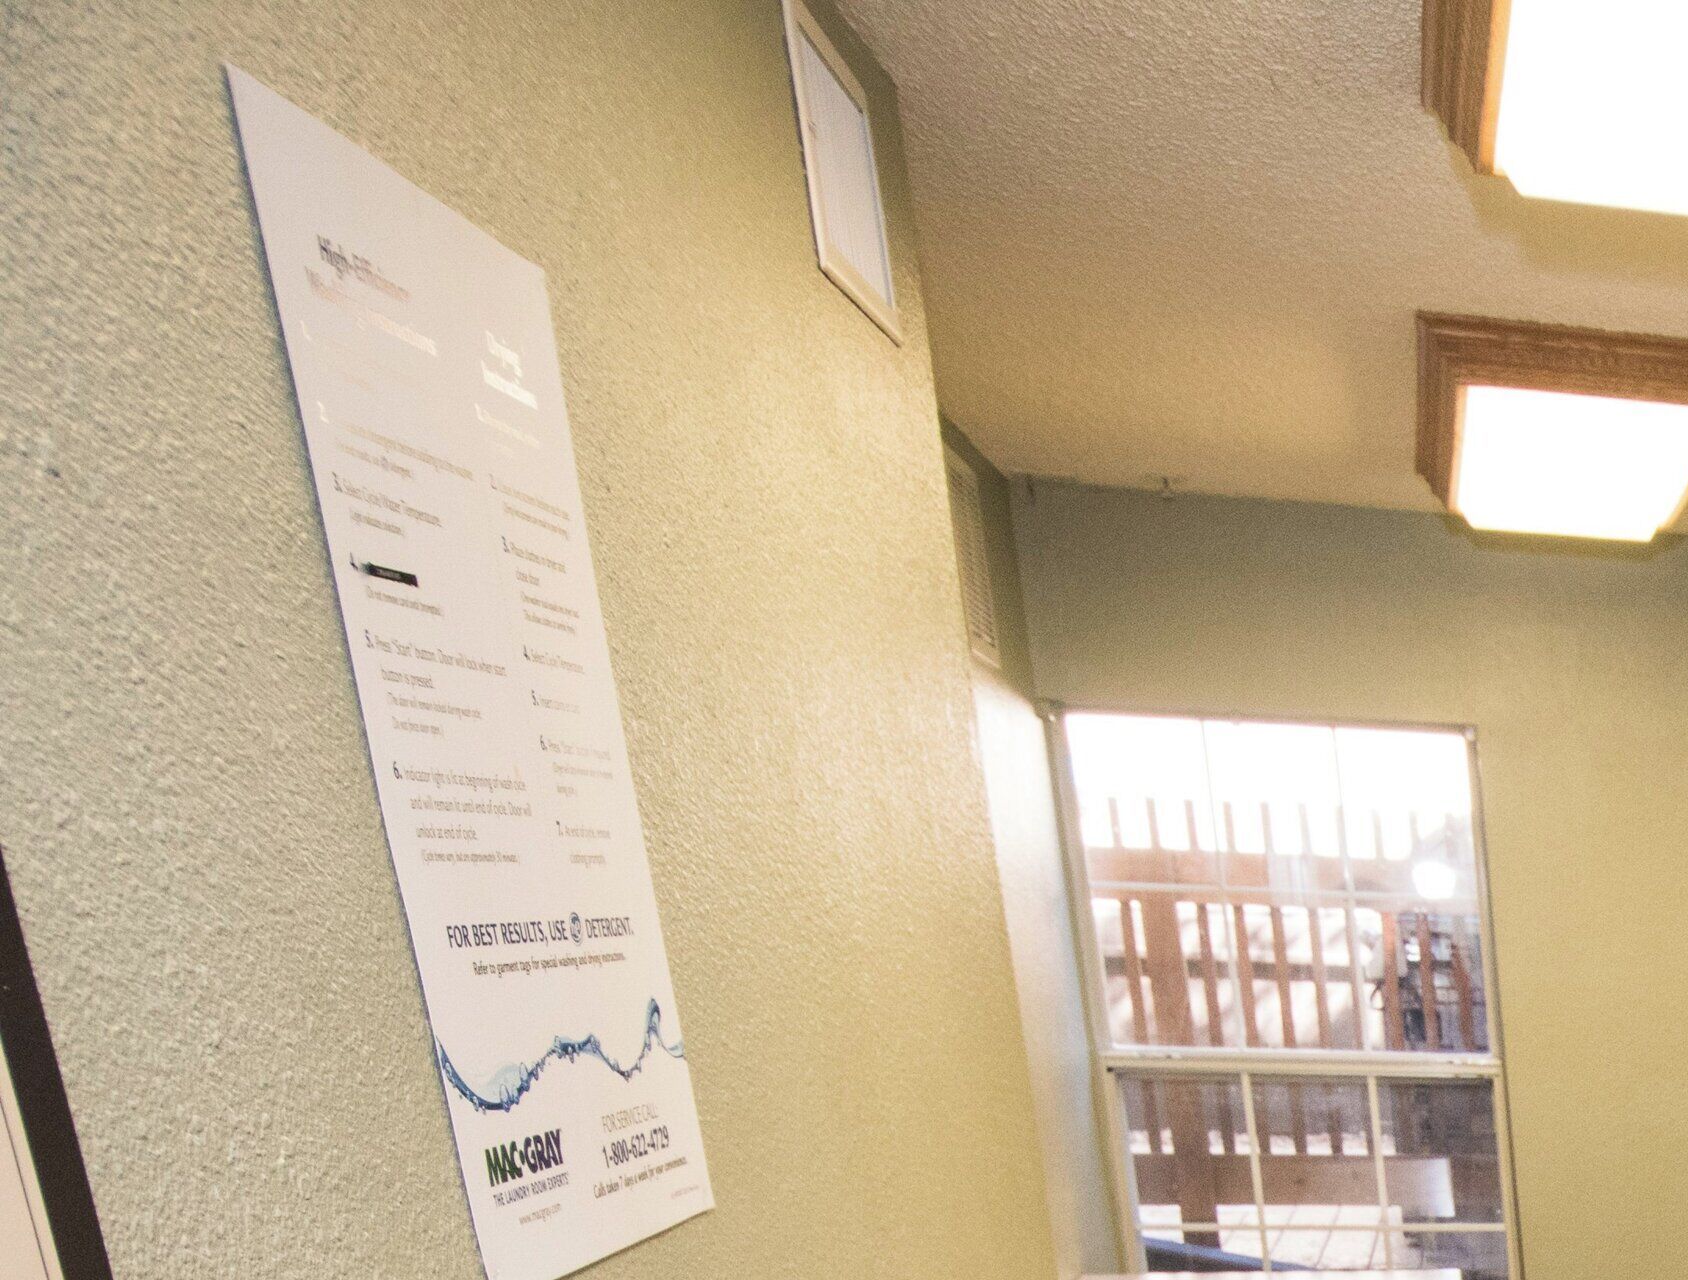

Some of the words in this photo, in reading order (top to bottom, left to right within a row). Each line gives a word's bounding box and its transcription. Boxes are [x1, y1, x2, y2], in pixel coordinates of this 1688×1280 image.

[391, 760, 403, 780] 6.
[446, 925, 472, 948] FOR
[472, 923, 499, 947] BEST
[500, 920, 549, 948] RESULTS,
[550, 920, 568, 942] USE
[585, 916, 634, 939] DETERGENT.
[472, 961, 488, 976] Refer
[489, 961, 497, 974] to
[497, 960, 519, 978] garment
[531, 956, 540, 970] for
[540, 955, 559, 972] special
[602, 1115, 616, 1134] FOR
[616, 1106, 642, 1130] SERVICE
[602, 1125, 669, 1169] 1-800-622-4729
[493, 1190, 505, 1208] THE
[504, 1185, 530, 1205] LAUNDRY
[531, 1180, 548, 1198] ROOM
[593, 1182, 606, 1199] Calls
